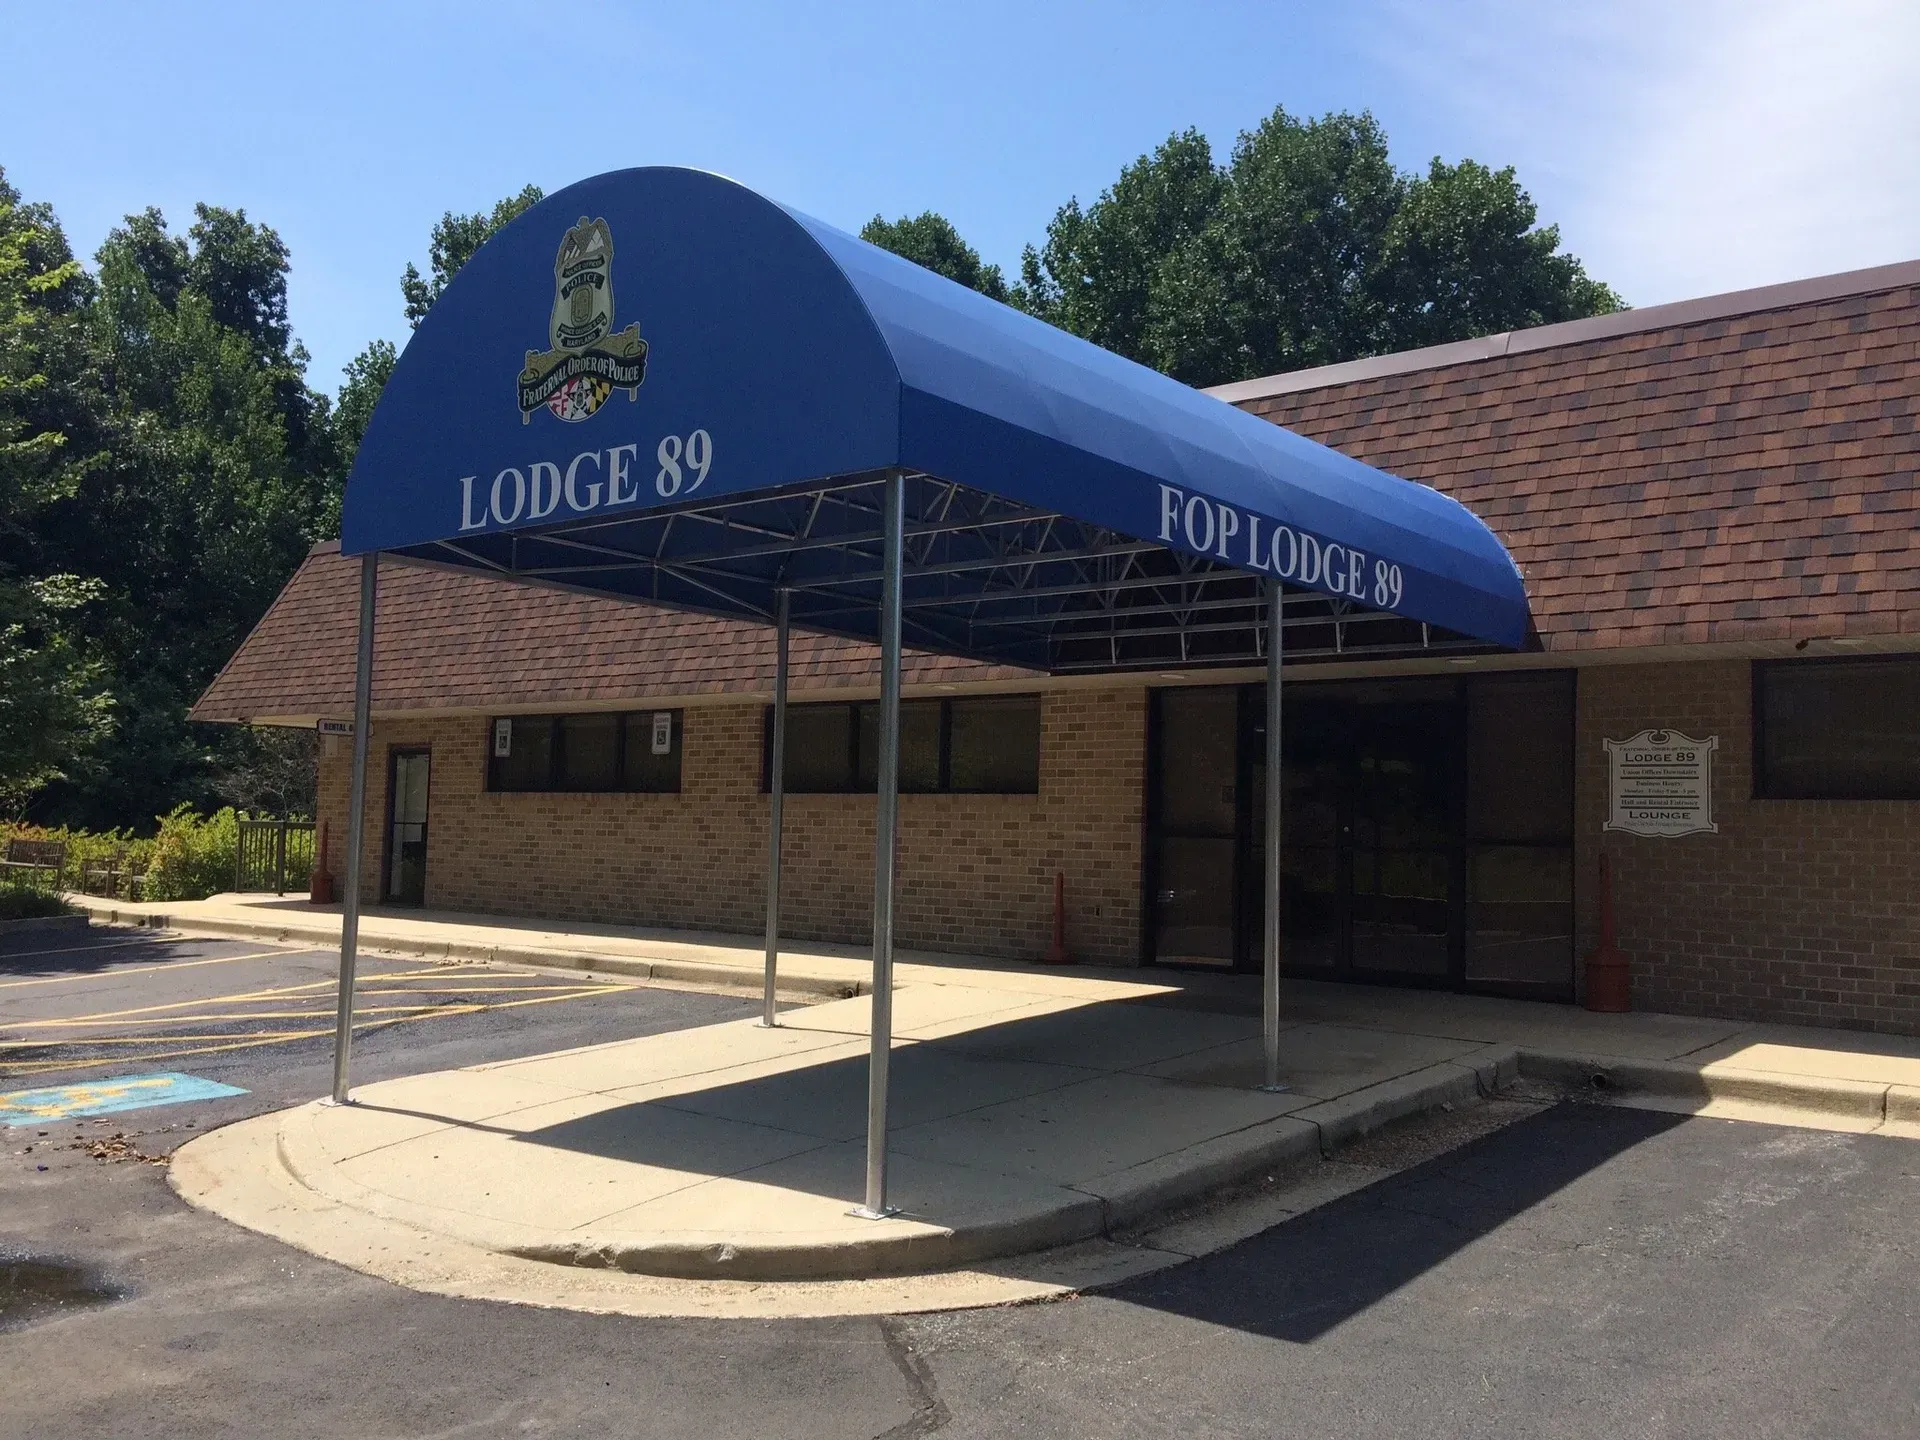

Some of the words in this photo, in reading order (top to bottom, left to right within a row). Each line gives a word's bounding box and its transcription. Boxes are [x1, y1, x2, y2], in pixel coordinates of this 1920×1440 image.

[565, 273, 598, 292] POLICE
[566, 332, 597, 347] MARYLAND
[523, 365, 568, 407] FRATERNAL
[567, 357, 597, 376] ORDER
[597, 358, 609, 375] OF
[608, 357, 640, 382] POLICE
[458, 443, 639, 531] LODGE
[655, 428, 713, 498] 89
[1157, 483, 1239, 559] FOP
[1246, 514, 1367, 600] LODGE
[1374, 559, 1403, 609] 89
[1625, 752, 1672, 762] LODGE
[1676, 752, 1696, 762] 89
[1629, 810, 1692, 820] LOUNGE
